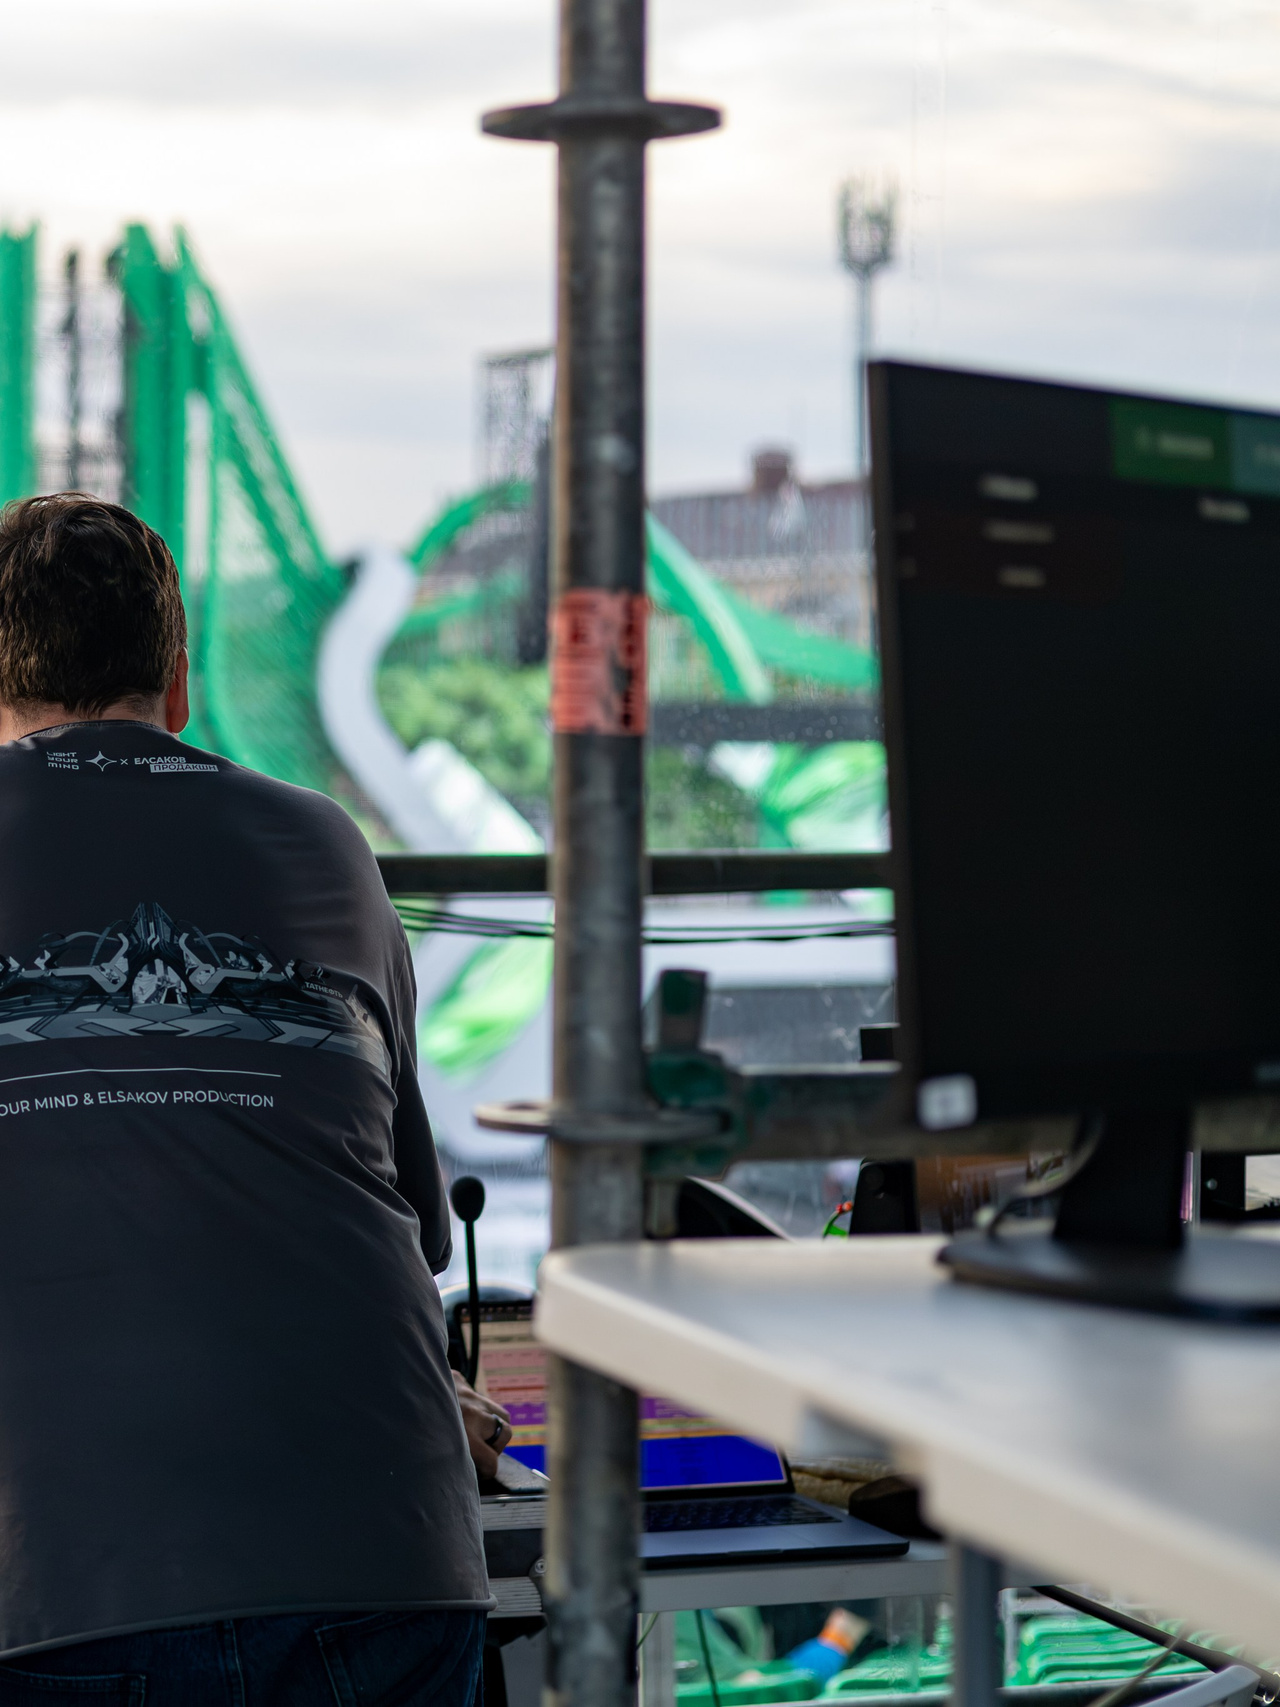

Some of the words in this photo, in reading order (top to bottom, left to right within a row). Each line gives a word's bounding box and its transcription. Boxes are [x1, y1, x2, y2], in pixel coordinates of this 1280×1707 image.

[47, 756, 79, 764] YOUR
[47, 762, 80, 770] MIND
[304, 981, 344, 998] ТАТНЕФТЬ
[34, 1094, 79, 1111] MIND
[83, 1092, 95, 1106] &
[97, 1090, 168, 1105] ELSAKOV
[173, 1090, 275, 1108] PRODUCTION
